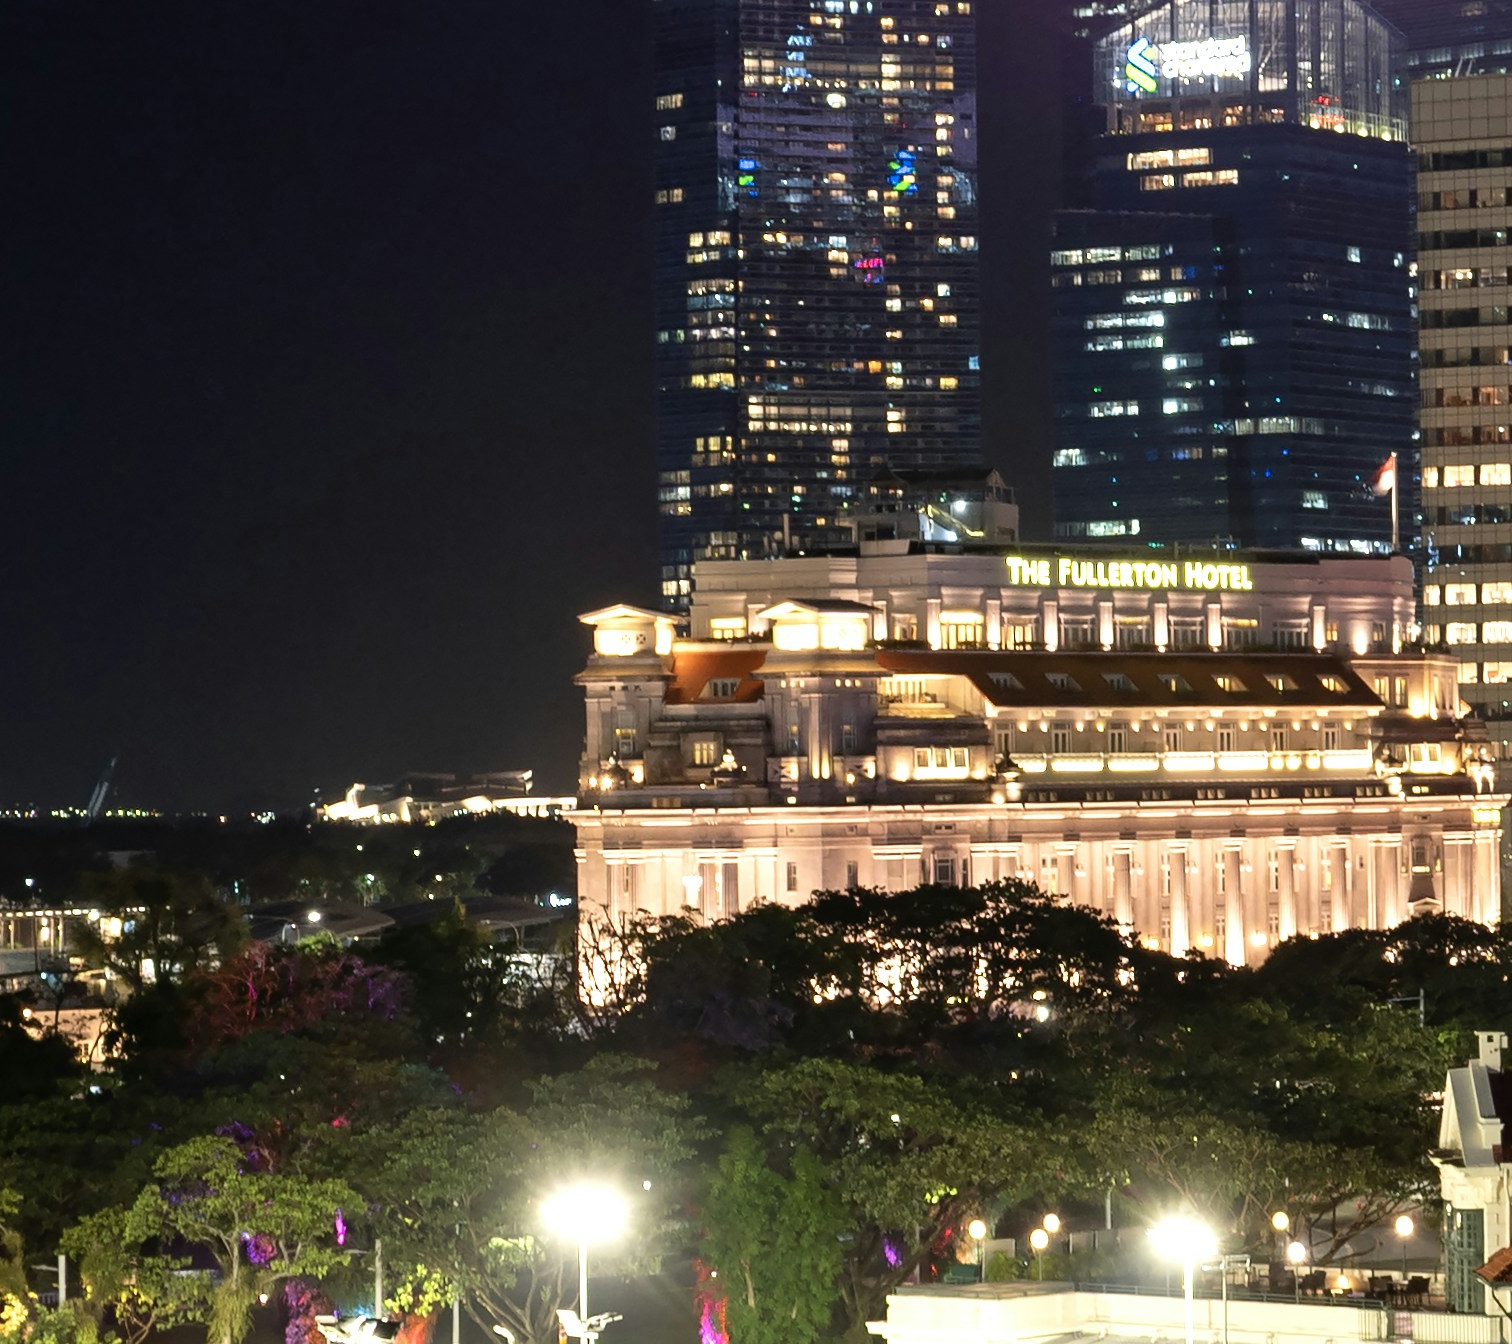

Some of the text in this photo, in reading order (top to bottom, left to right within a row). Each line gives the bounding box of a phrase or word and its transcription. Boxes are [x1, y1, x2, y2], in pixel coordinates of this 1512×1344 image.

[1006, 556, 1254, 591] THE FULLERTON HOTEL
